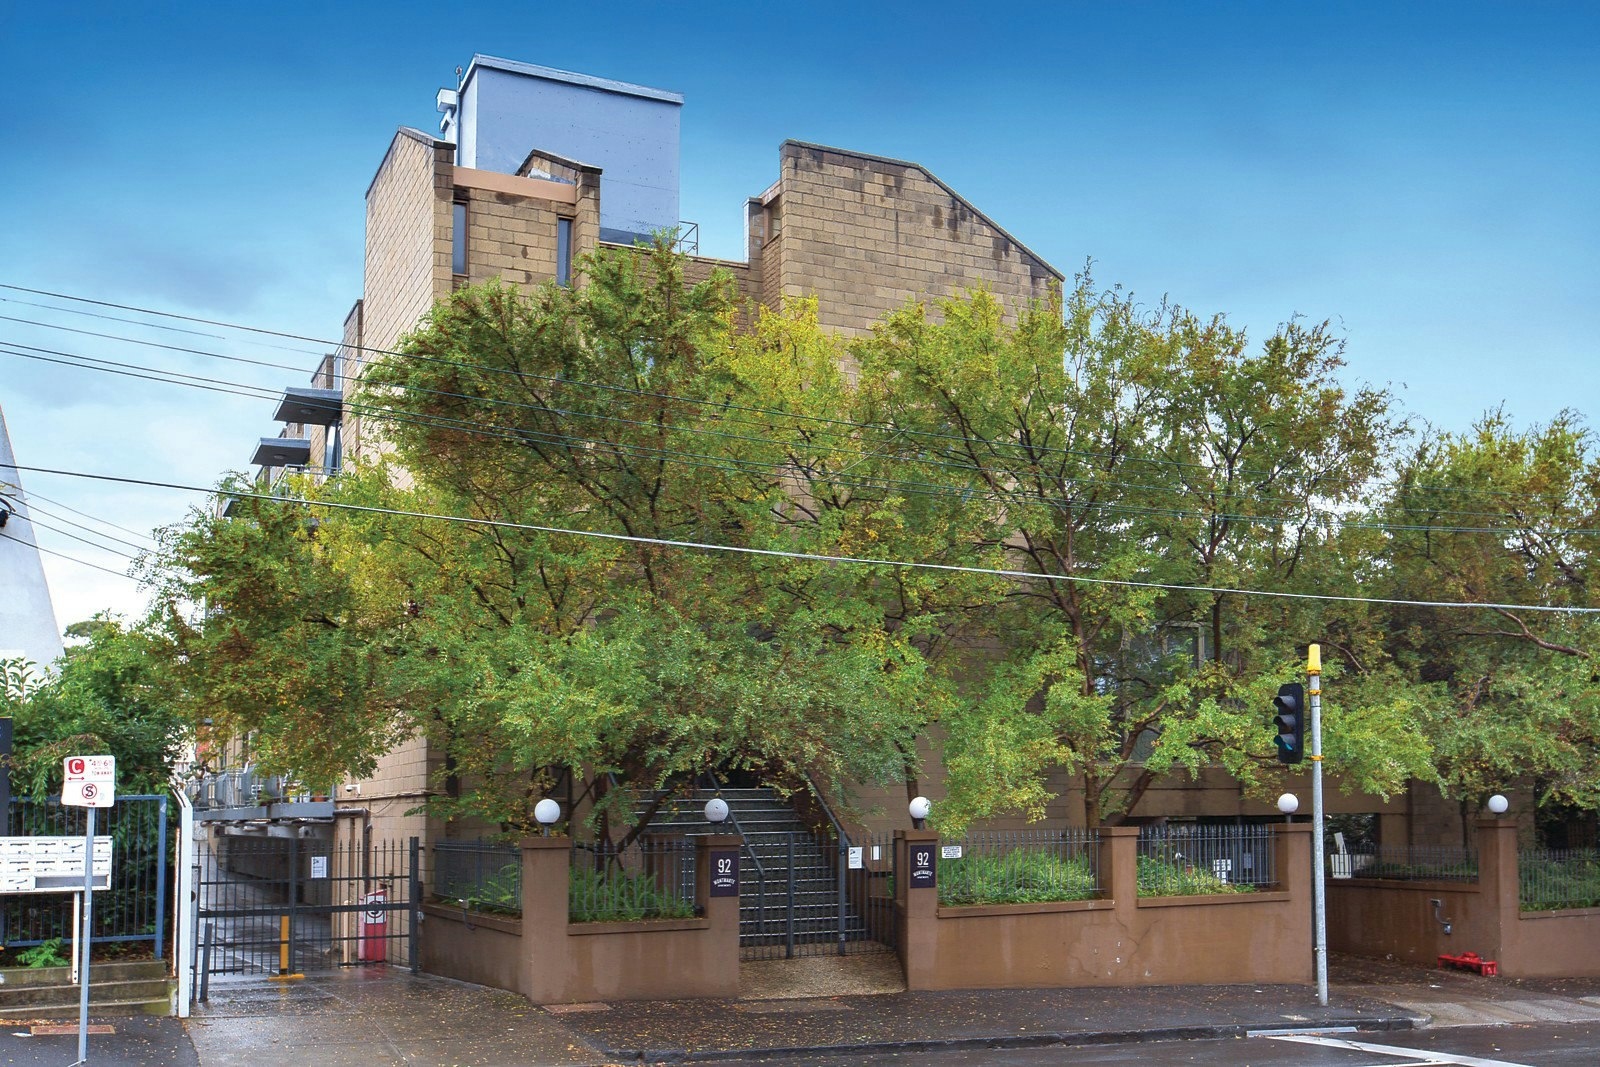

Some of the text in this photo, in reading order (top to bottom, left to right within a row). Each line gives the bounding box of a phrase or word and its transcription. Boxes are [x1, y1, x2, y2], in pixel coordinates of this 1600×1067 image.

[72, 760, 82, 774] C
[718, 858, 732, 873] 92
[917, 852, 929, 866] 92
